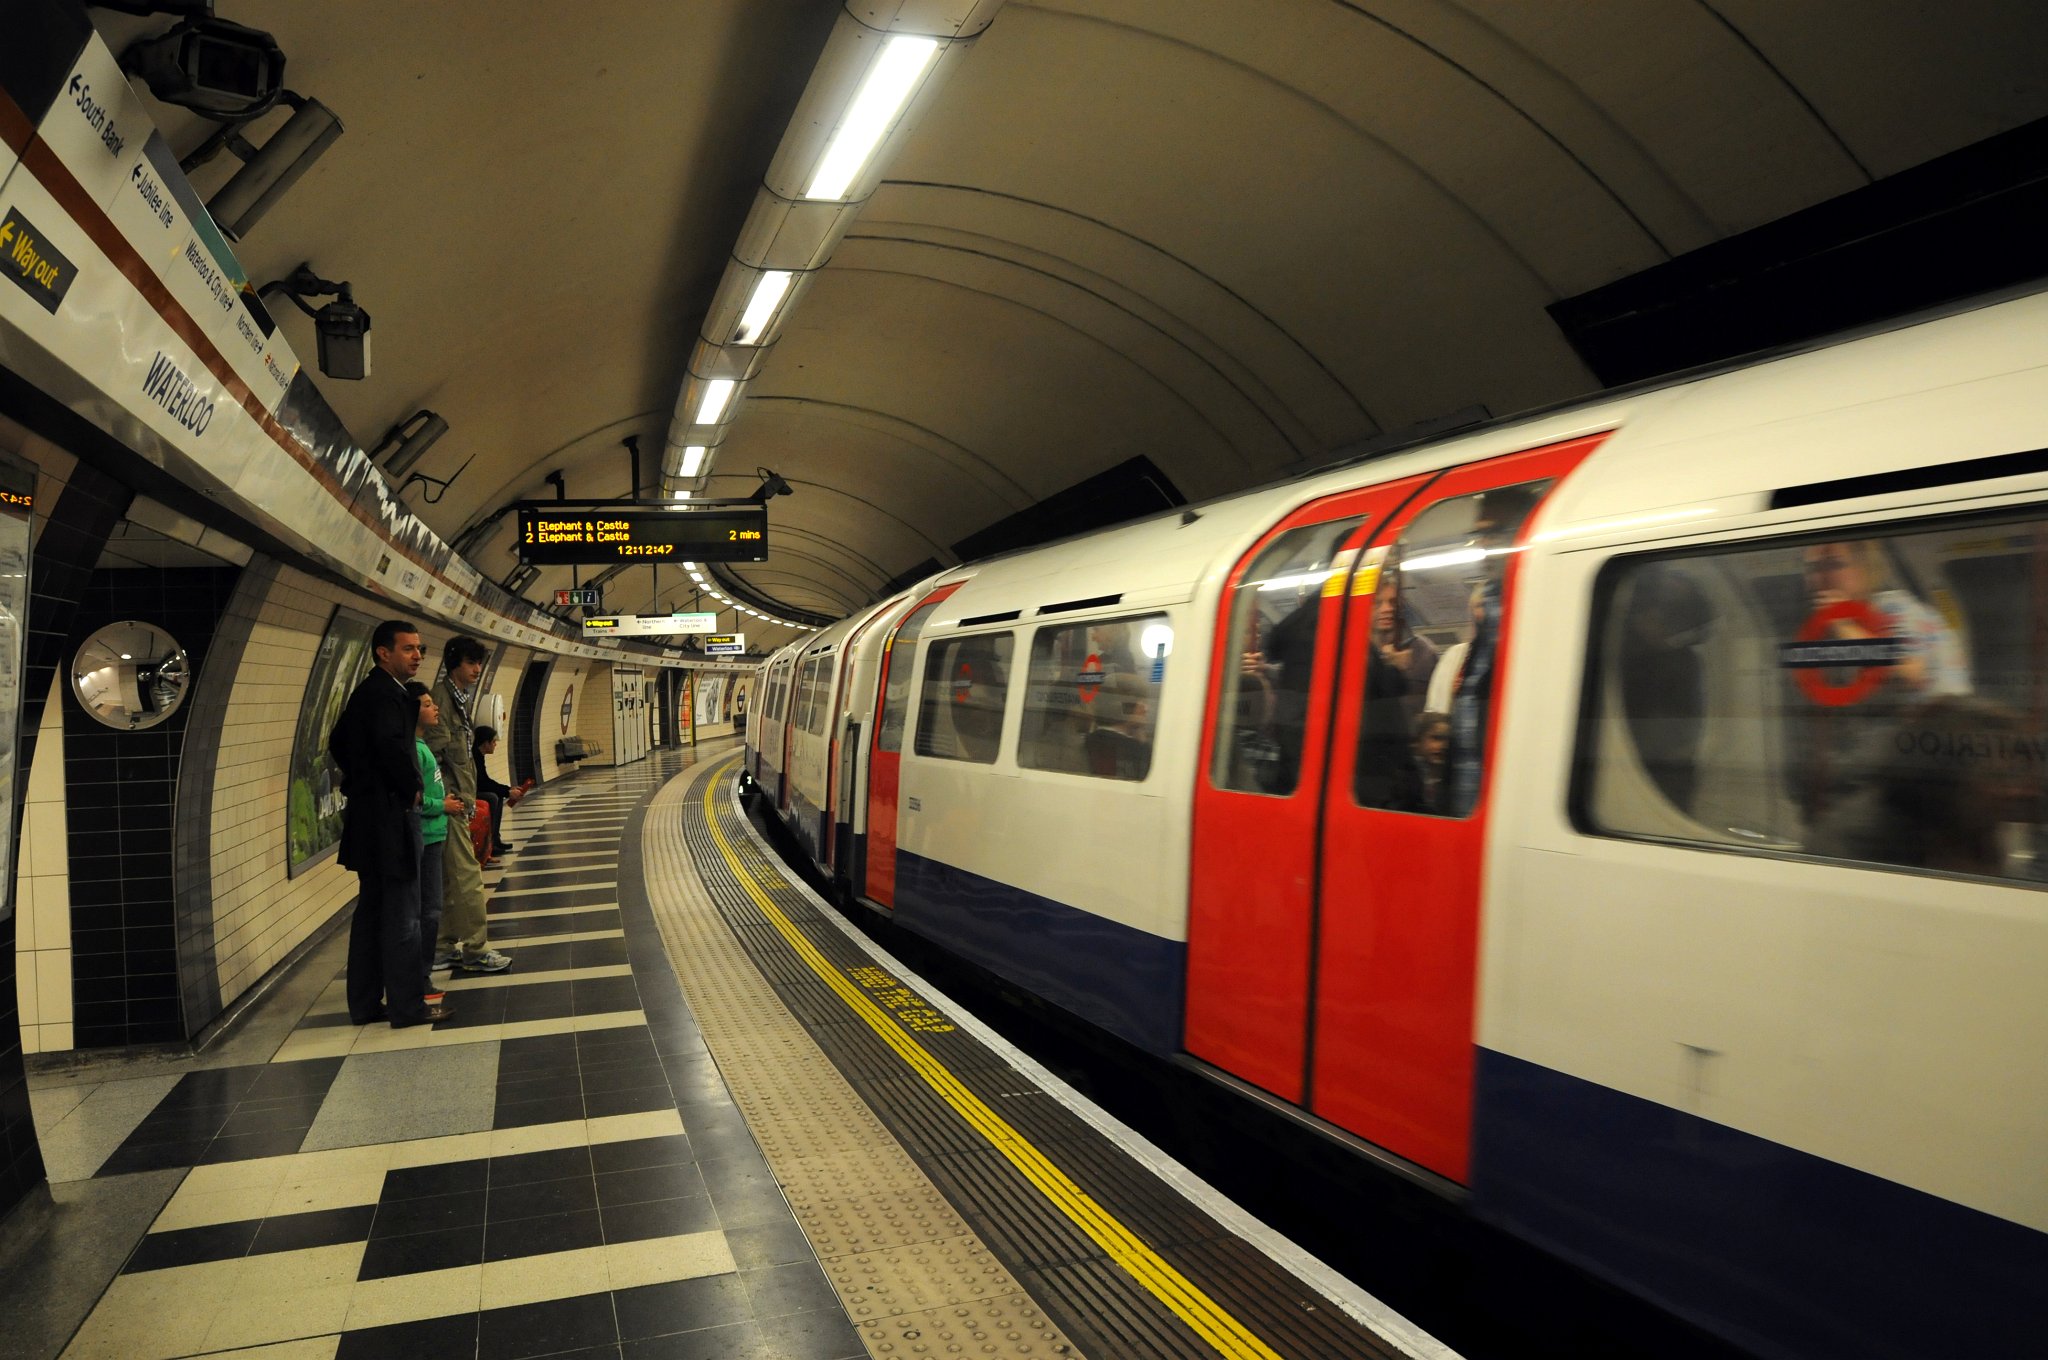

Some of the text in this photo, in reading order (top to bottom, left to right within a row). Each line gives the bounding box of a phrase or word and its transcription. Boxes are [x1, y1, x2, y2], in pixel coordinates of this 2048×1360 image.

[76, 84, 124, 158] South Bank
[137, 172, 173, 229] Jubilee line
[11, 229, 59, 289] Way out
[185, 238, 230, 309] Waterloo & City line
[142, 350, 214, 437] WATERLOO
[526, 531, 630, 544] 2 Elephant & Castle
[527, 520, 630, 533] 1 Elephant & Castle
[729, 530, 761, 541] 2 mins
[617, 545, 673, 555] 12:12:47
[591, 620, 603, 628] Way
